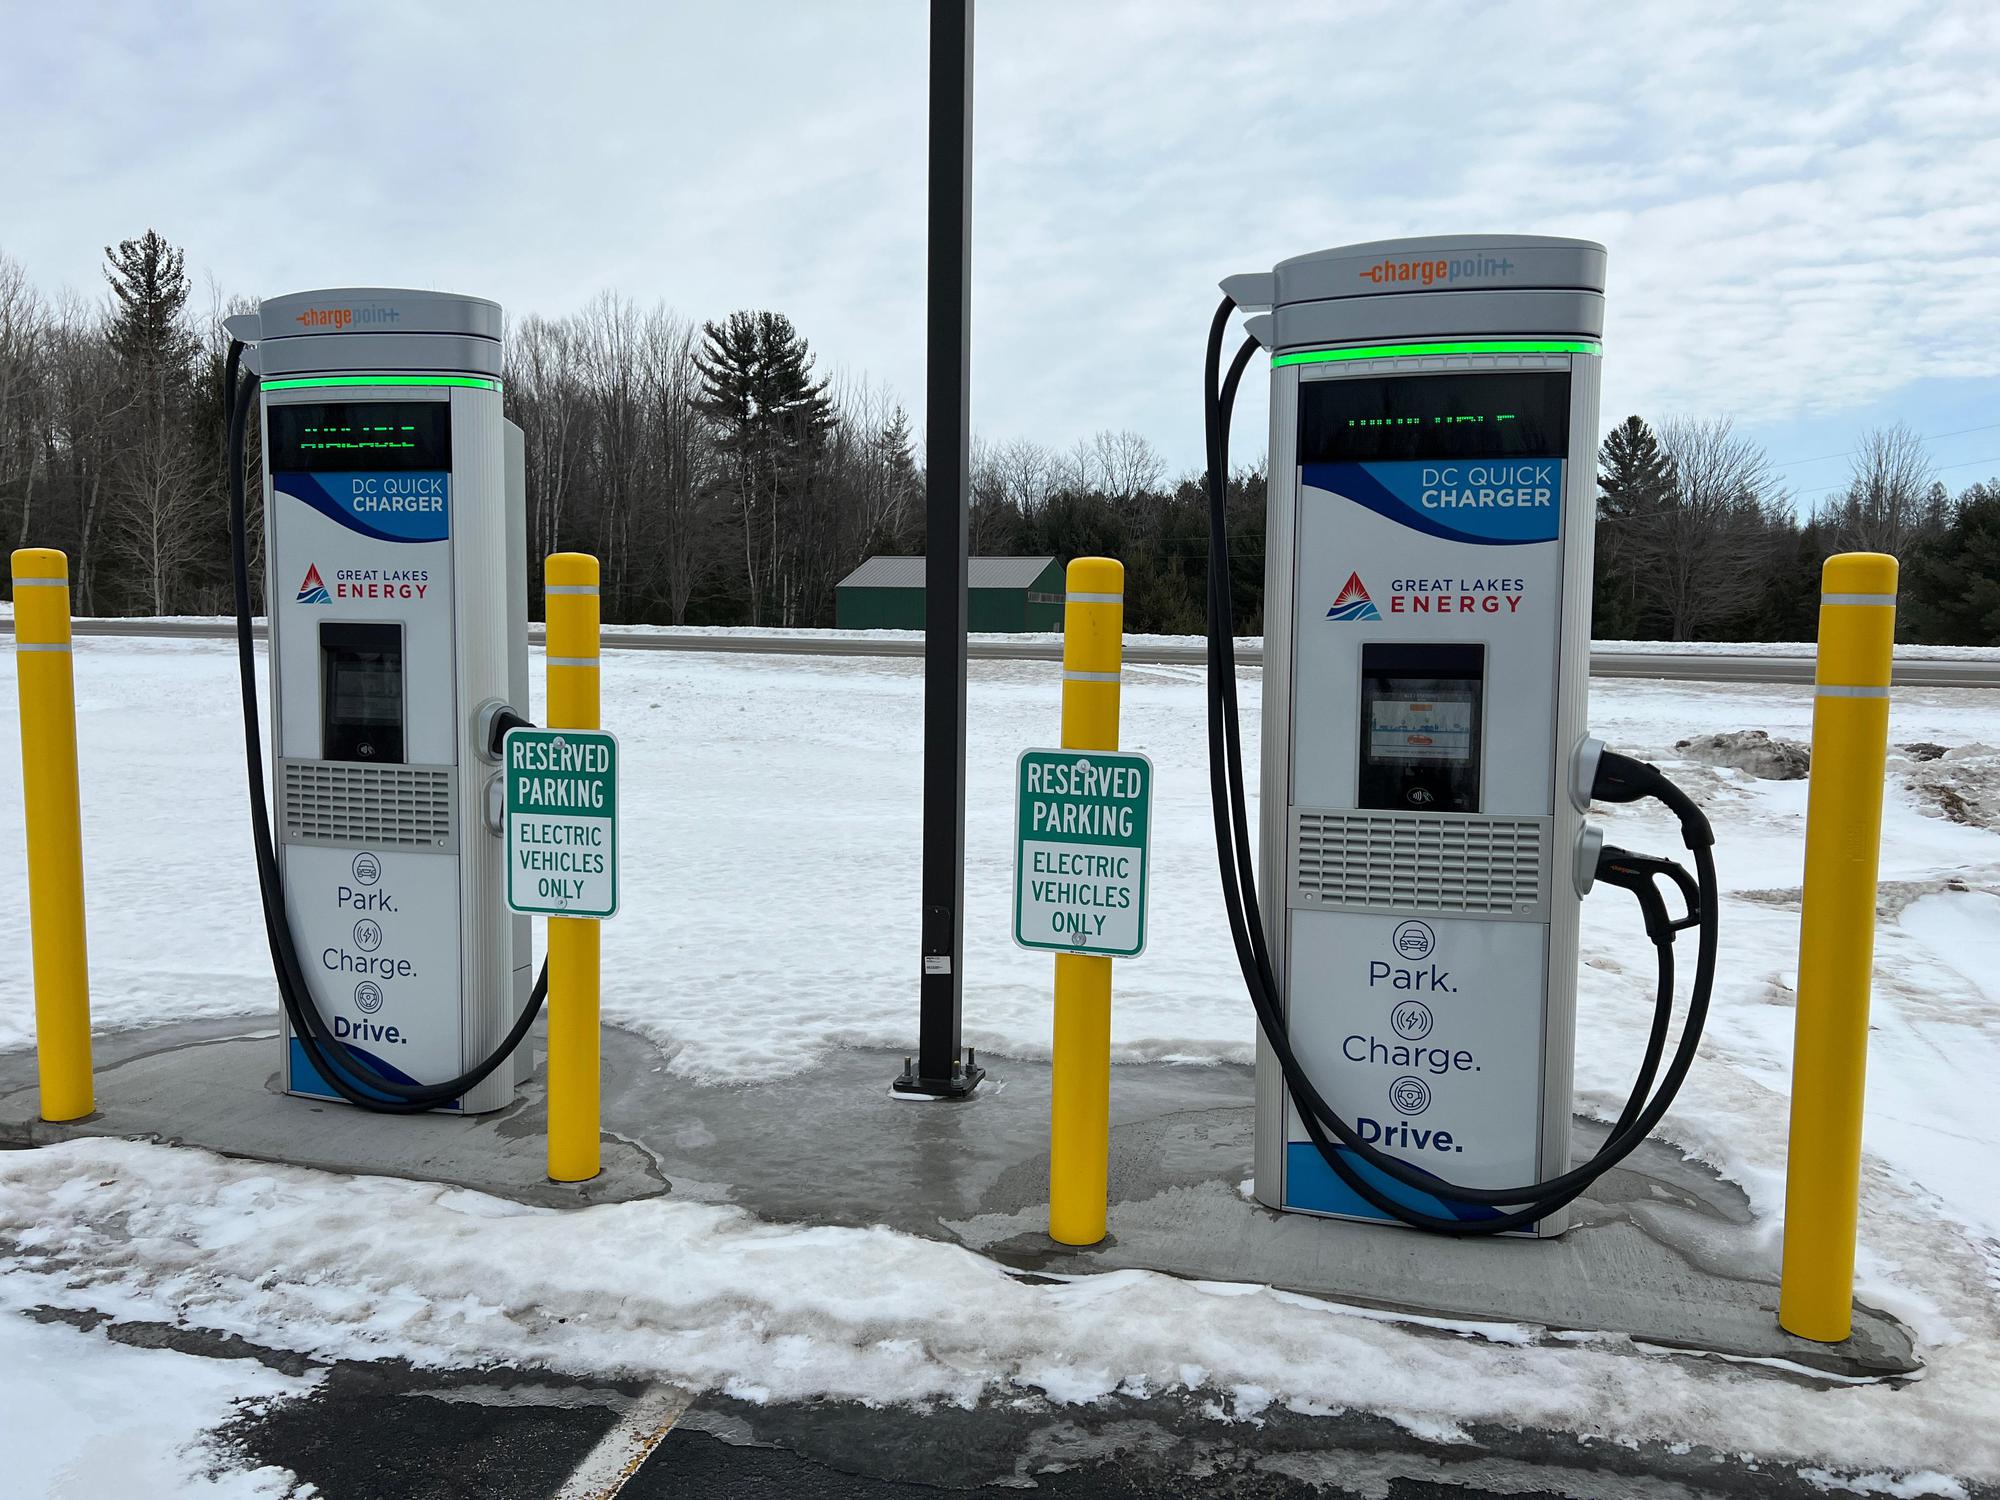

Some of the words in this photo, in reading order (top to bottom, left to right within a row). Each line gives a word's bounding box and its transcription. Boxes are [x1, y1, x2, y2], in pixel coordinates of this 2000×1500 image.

[352, 478, 378, 494] DC
[383, 478, 443, 494] QUICK
[1422, 467, 1458, 487] DC
[1468, 465, 1552, 486] QUICK
[353, 496, 443, 512] CHARGER
[1421, 488, 1551, 508] CHARGER
[337, 569, 379, 581] GREAT
[383, 570, 429, 581] LAKES
[1391, 579, 1454, 592] GREAT
[1460, 578, 1524, 592] LAKES
[337, 583, 428, 599] ENERGY
[1391, 595, 1522, 613] ENERGY
[512, 741, 610, 773] RESERVED
[518, 776, 604, 809] PARKING
[1027, 762, 1142, 799] RESERVED
[1032, 801, 1134, 838] PARKING
[520, 823, 602, 847] ELECTRIC
[519, 849, 604, 874] VEHICLES
[1033, 851, 1130, 879] ELECTRIC
[337, 886, 398, 912] Park.
[538, 877, 585, 899] ONLY
[1031, 880, 1131, 909] VEHICLES
[1051, 911, 1107, 936] ONLY
[322, 948, 418, 980] Charge.
[1369, 960, 1458, 993] Park.
[334, 1015, 407, 1044] Drive.
[1342, 1035, 1481, 1075] Charge.
[1357, 1117, 1463, 1153] Drive.
